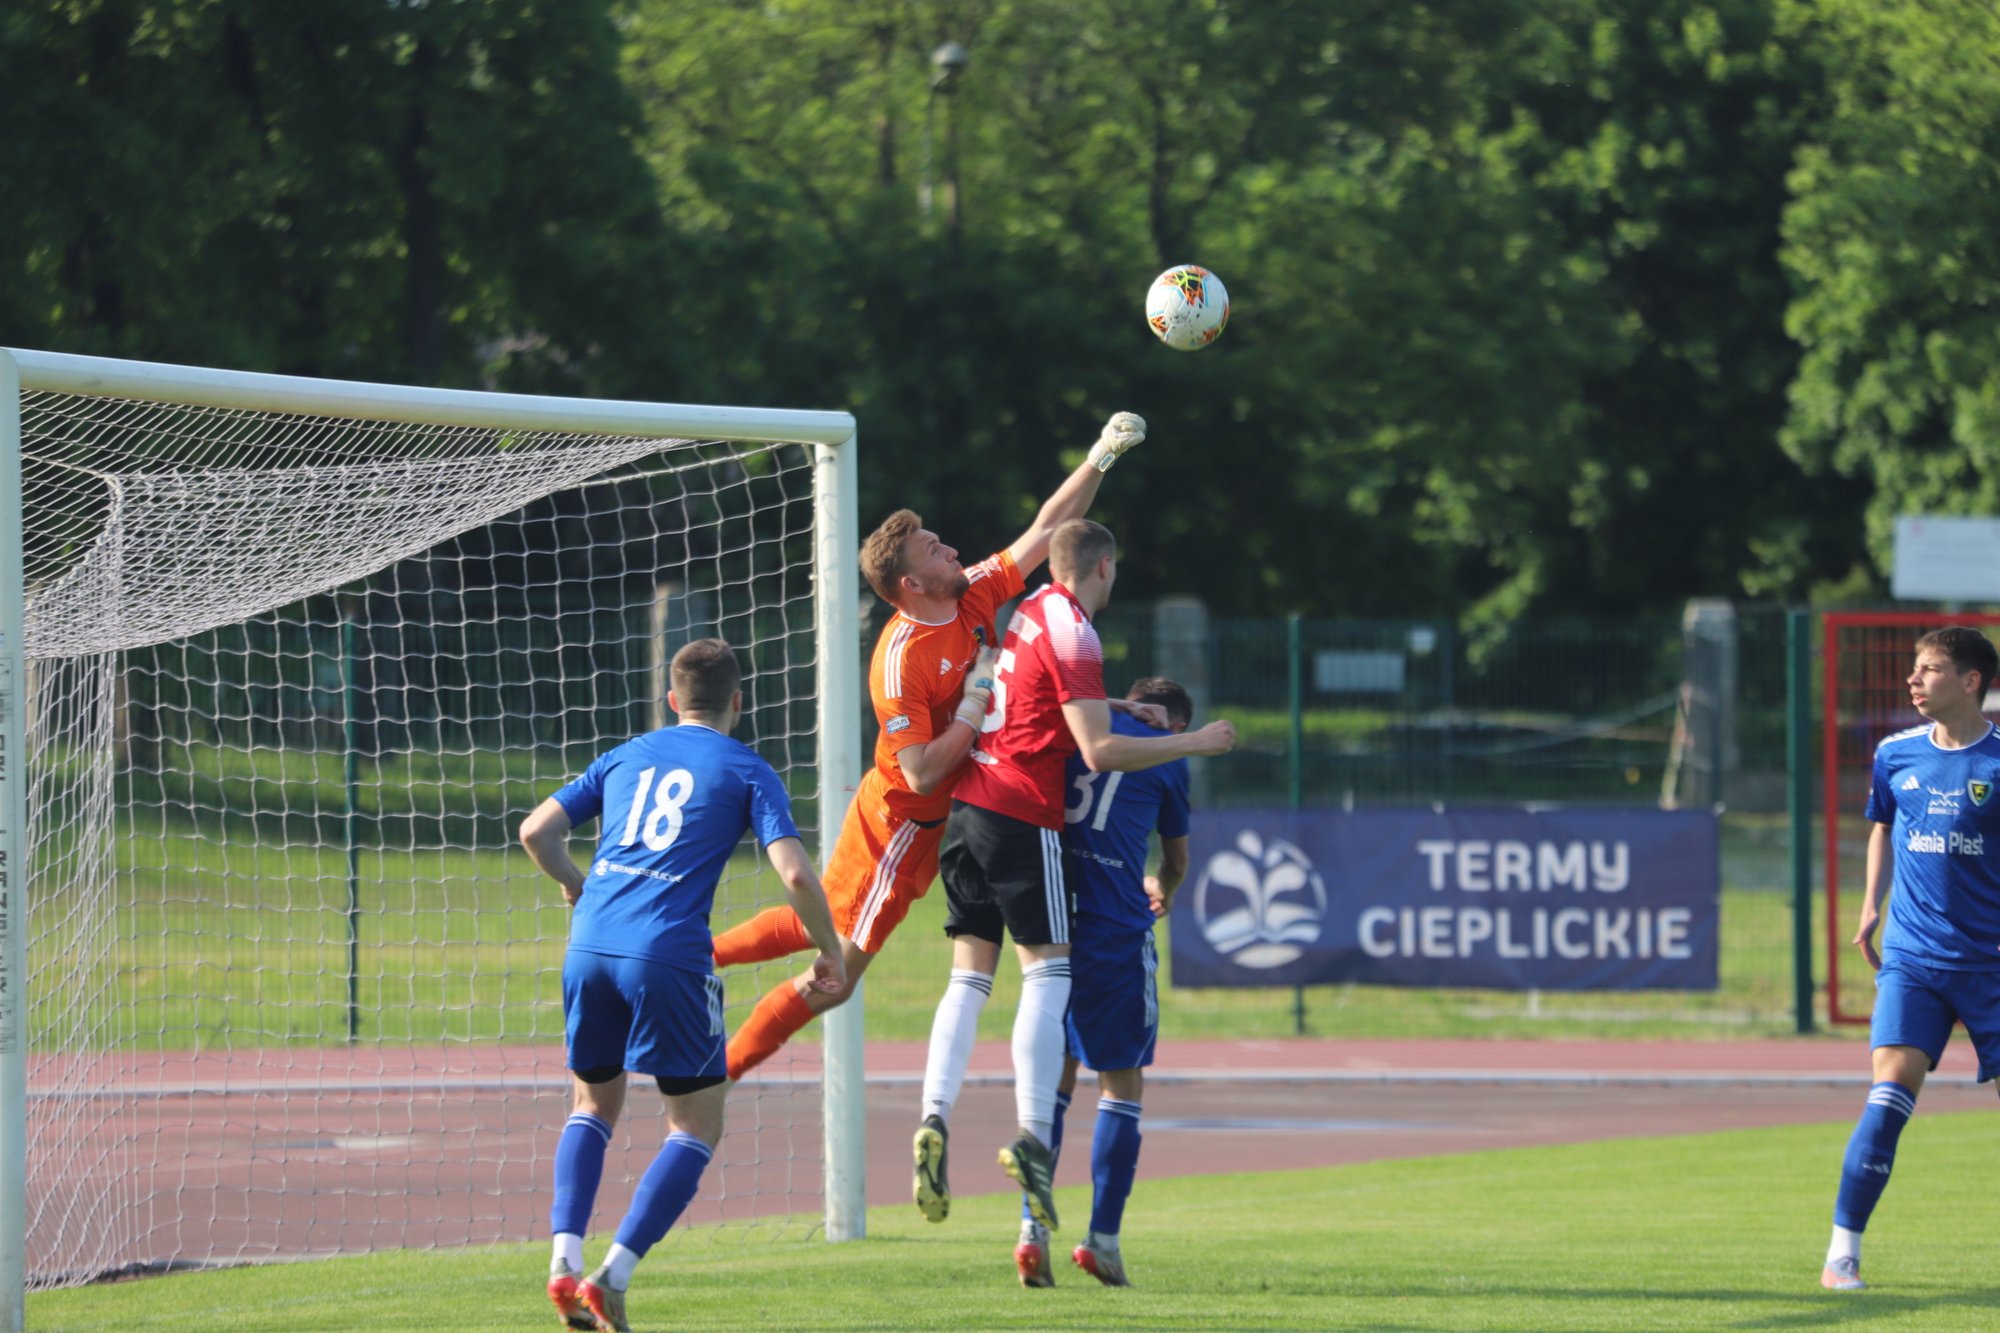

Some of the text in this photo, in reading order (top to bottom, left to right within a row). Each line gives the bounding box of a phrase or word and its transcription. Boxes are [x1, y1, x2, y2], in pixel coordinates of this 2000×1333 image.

[619, 766, 694, 852] 18
[1417, 840, 1630, 892] TERMY
[1948, 831, 1984, 855] Plast
[1357, 907, 1692, 959] CIEPLICKIE
